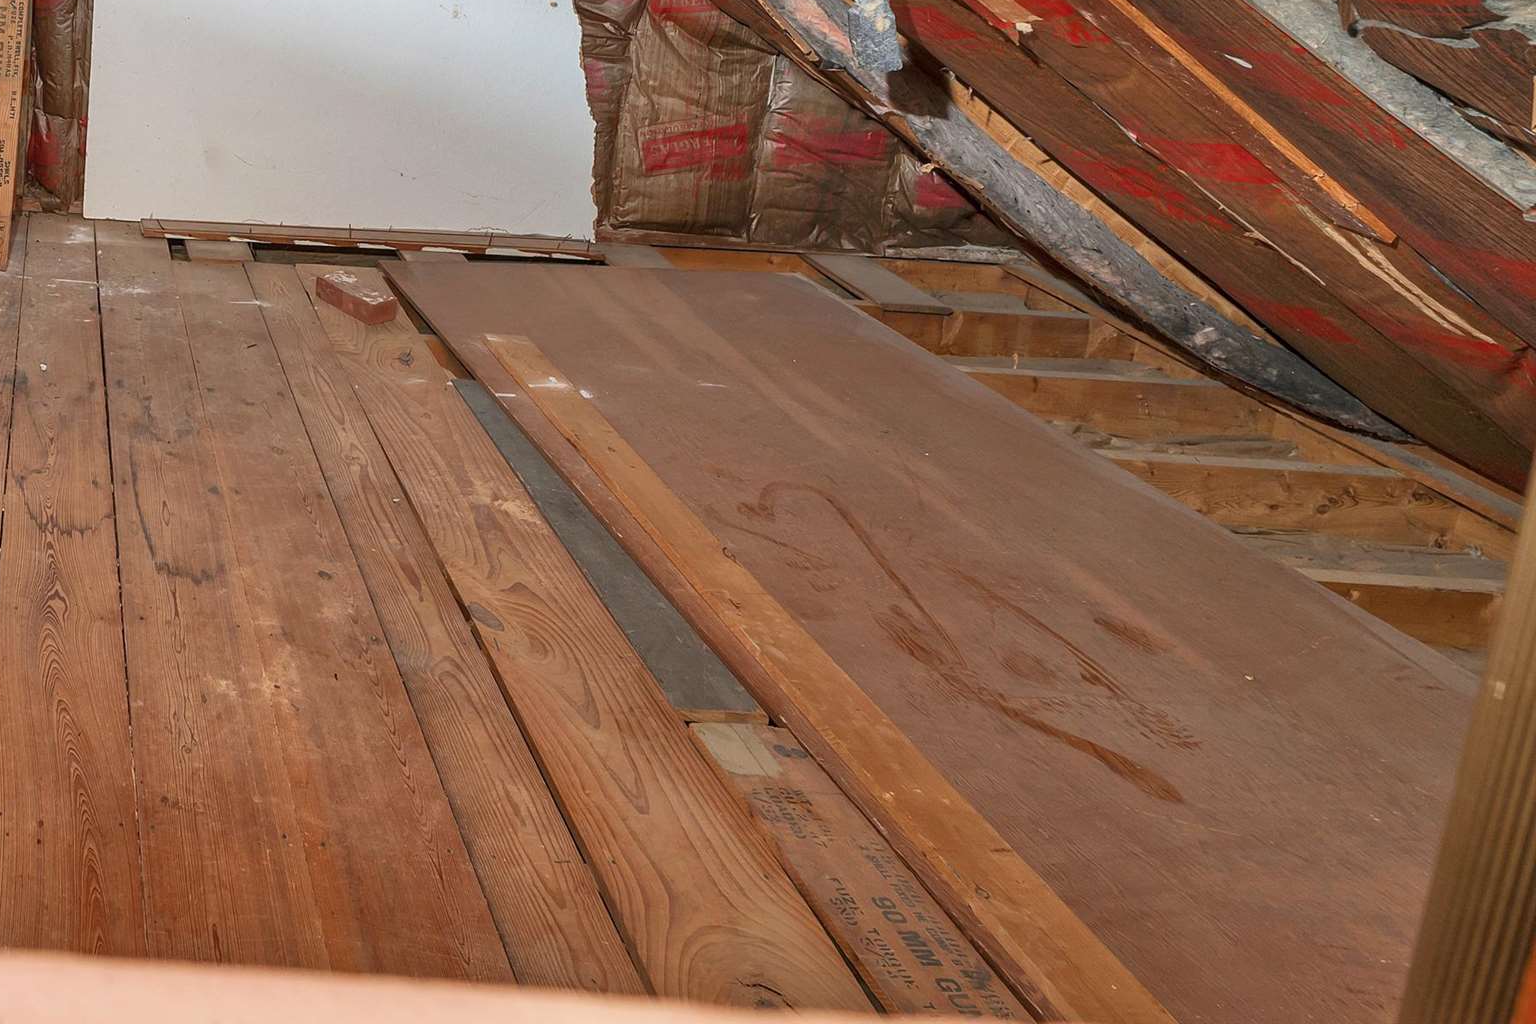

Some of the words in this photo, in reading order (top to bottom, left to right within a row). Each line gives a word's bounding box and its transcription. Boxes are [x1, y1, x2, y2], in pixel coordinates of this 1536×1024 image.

[827, 876, 865, 916] FUZE
[871, 895, 908, 924] 90
[895, 930, 944, 968] MM
